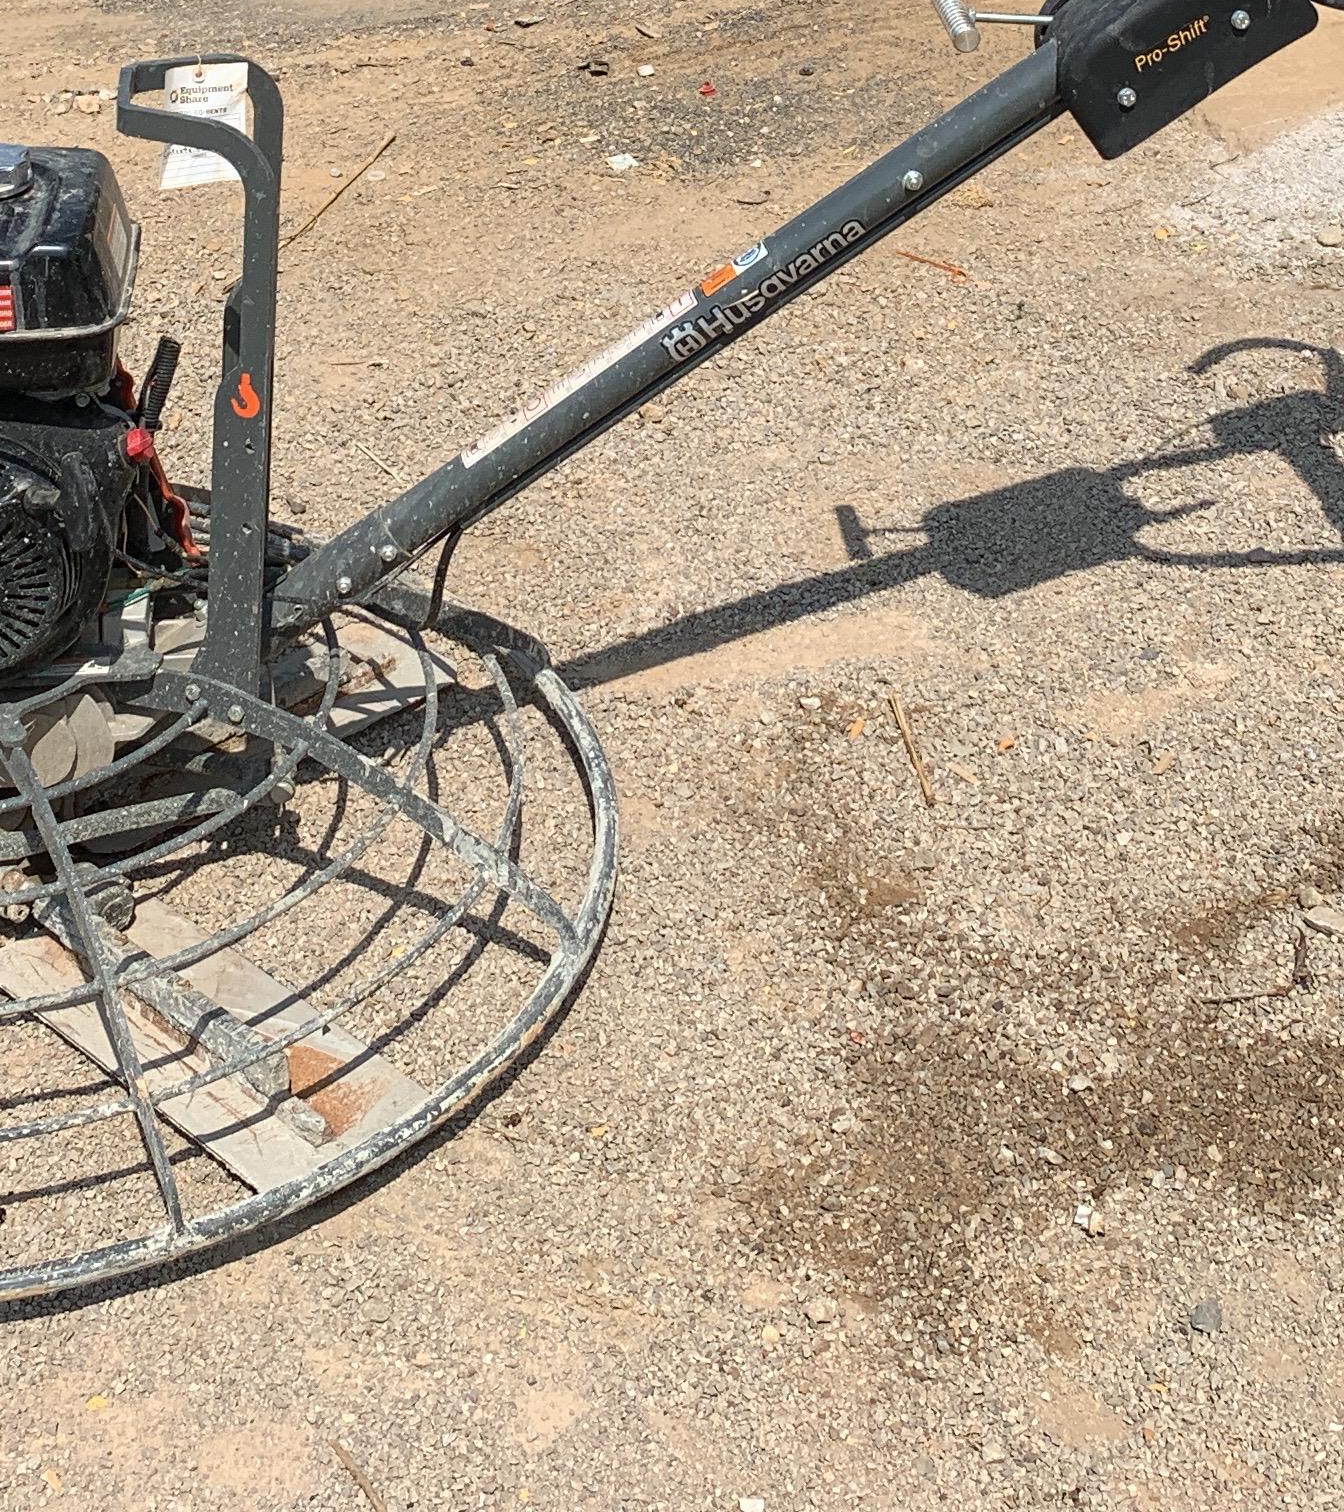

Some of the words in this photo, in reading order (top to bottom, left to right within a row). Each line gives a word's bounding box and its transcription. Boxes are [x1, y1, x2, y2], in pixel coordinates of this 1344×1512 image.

[180, 84, 234, 96] Equipment
[180, 94, 209, 104] Share
[697, 219, 867, 338] Husqvarna
